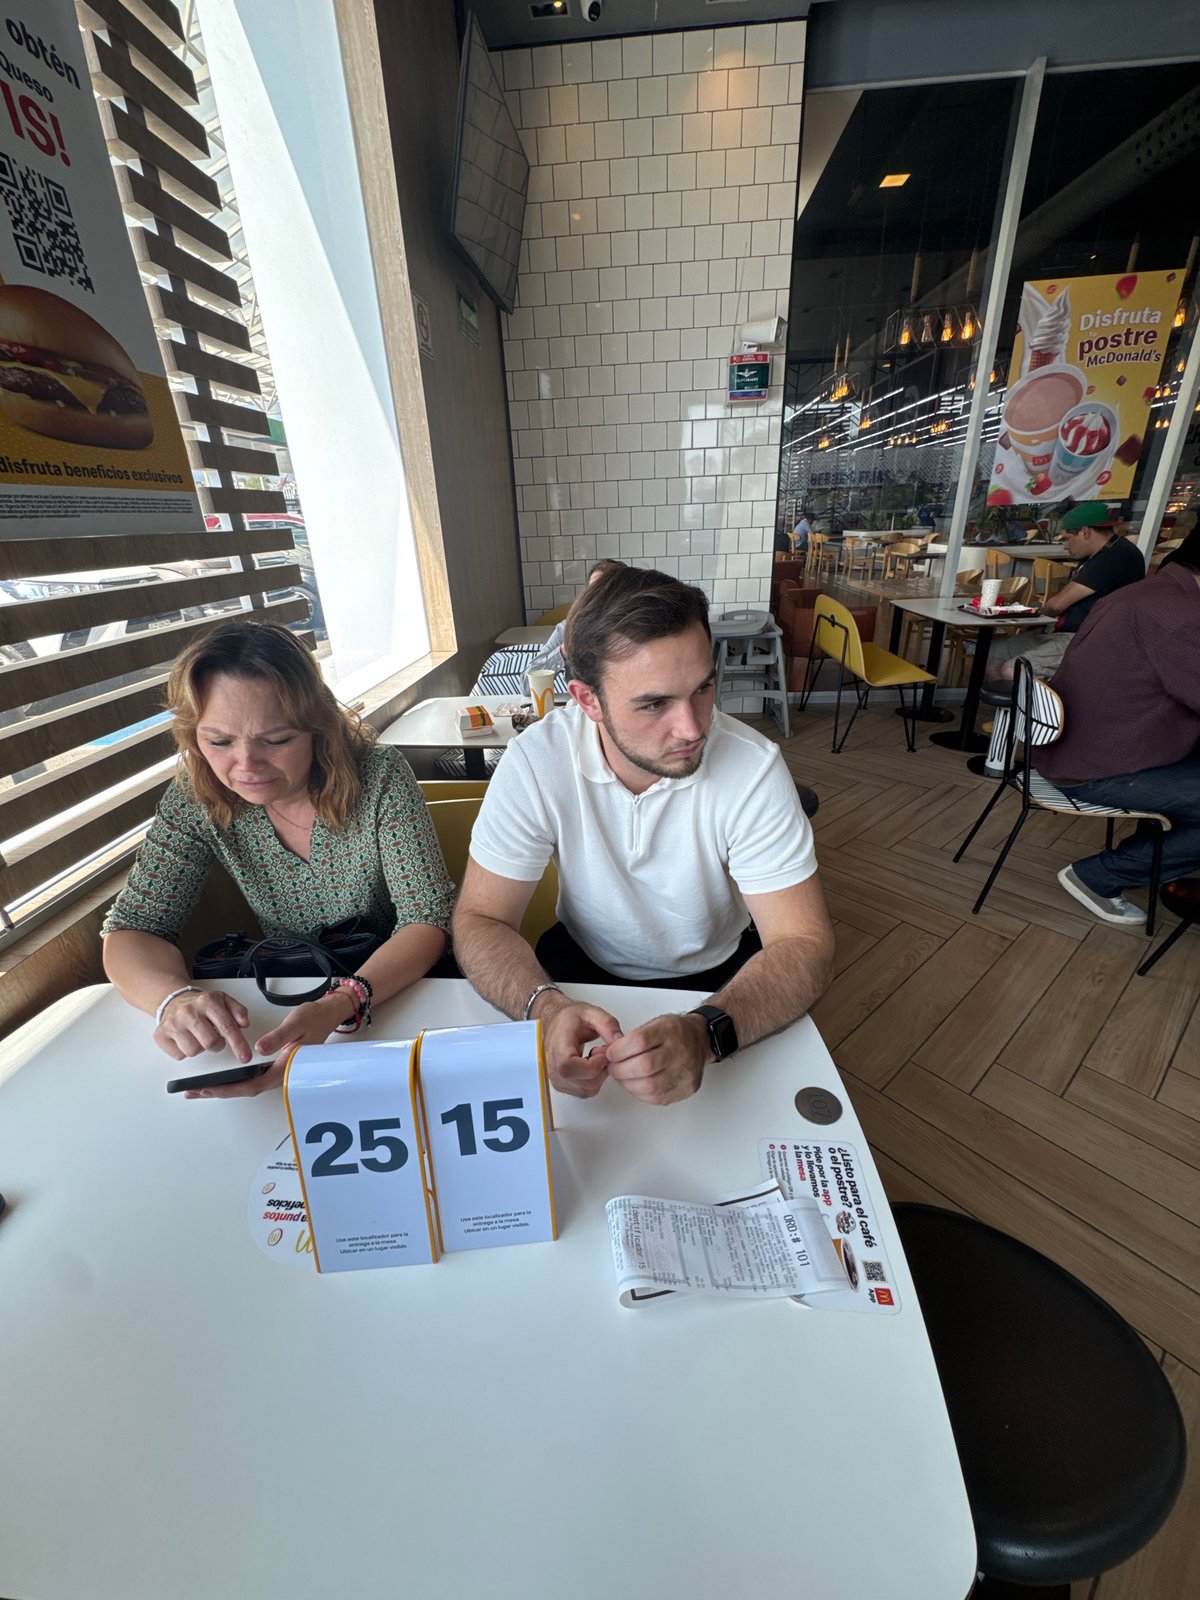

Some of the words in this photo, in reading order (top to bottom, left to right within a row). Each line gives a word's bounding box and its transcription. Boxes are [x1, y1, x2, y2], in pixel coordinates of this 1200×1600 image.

[6, 18, 81, 90] obtén
[1080, 307, 1162, 331] Disfruta
[1078, 328, 1158, 361] postre
[1086, 349, 1162, 367] McDonald's
[0, 456, 62, 477] disfruta
[63, 462, 130, 481] beneficios
[131, 469, 184, 484] exclusivos
[440, 1097, 531, 1156] 15
[305, 1117, 409, 1177] 25
[795, 1151, 803, 1159] la
[813, 1145, 823, 1163] Pide
[796, 1159, 807, 1181] mesa
[831, 1155, 842, 1165] el
[837, 1147, 854, 1179] ¿Listo
[806, 1160, 820, 1198] llevamos
[817, 1164, 826, 1180] por
[820, 1180, 829, 1188] la
[830, 1166, 853, 1209] postre?
[846, 1180, 862, 1206] para
[267, 1199, 306, 1210] neficios
[821, 1189, 832, 1207] app
[263, 1211, 303, 1222] puntos
[856, 1207, 868, 1219] el
[631, 1205, 643, 1257] Identificador
[639, 1262, 647, 1270] 15
[860, 1220, 877, 1248] café
[795, 1249, 810, 1266] 101
[868, 1287, 876, 1304] App
